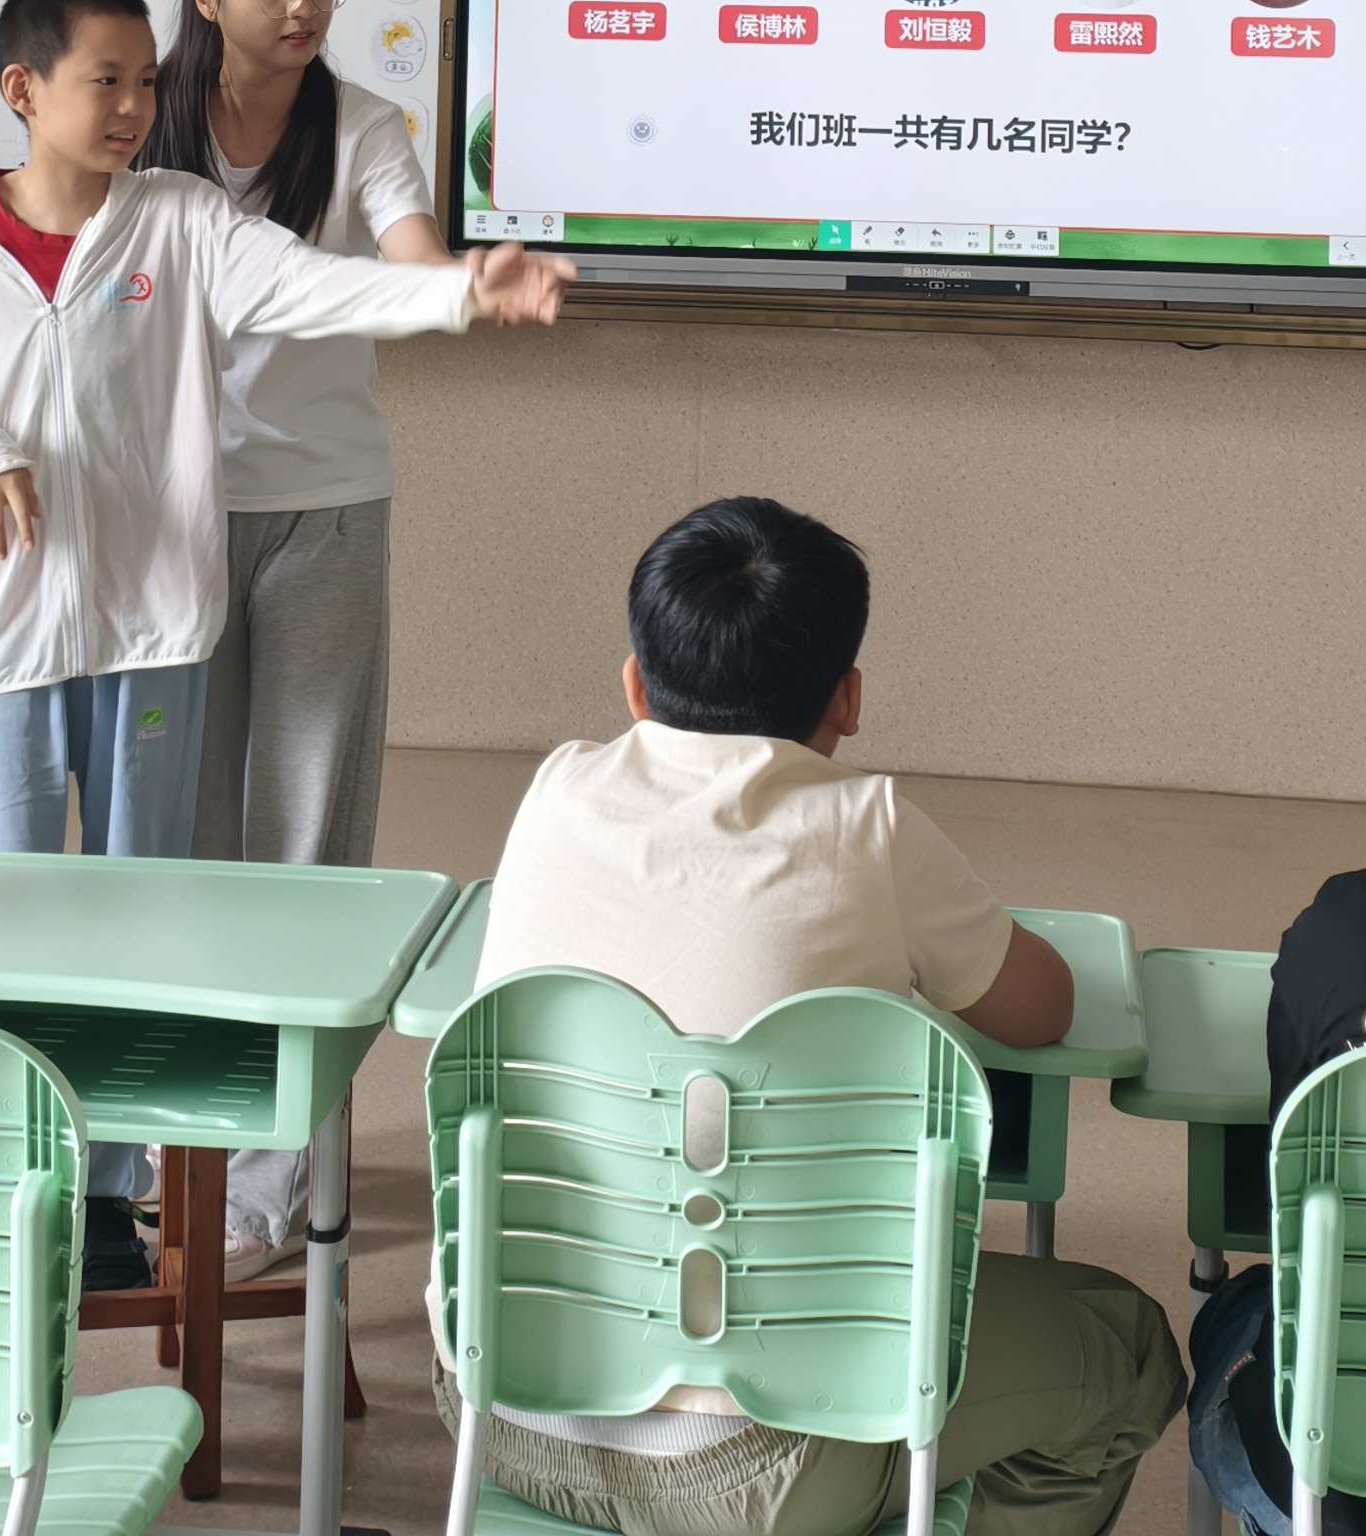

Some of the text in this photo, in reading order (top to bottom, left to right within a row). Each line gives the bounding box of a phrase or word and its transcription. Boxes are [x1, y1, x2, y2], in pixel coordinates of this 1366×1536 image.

[584, 9, 656, 36] 杨茗宇
[734, 13, 808, 40] 侯博林
[898, 16, 973, 43] 刘恒毅
[1069, 20, 1144, 47] 雷熙然
[1245, 24, 1323, 51] 钱艺木
